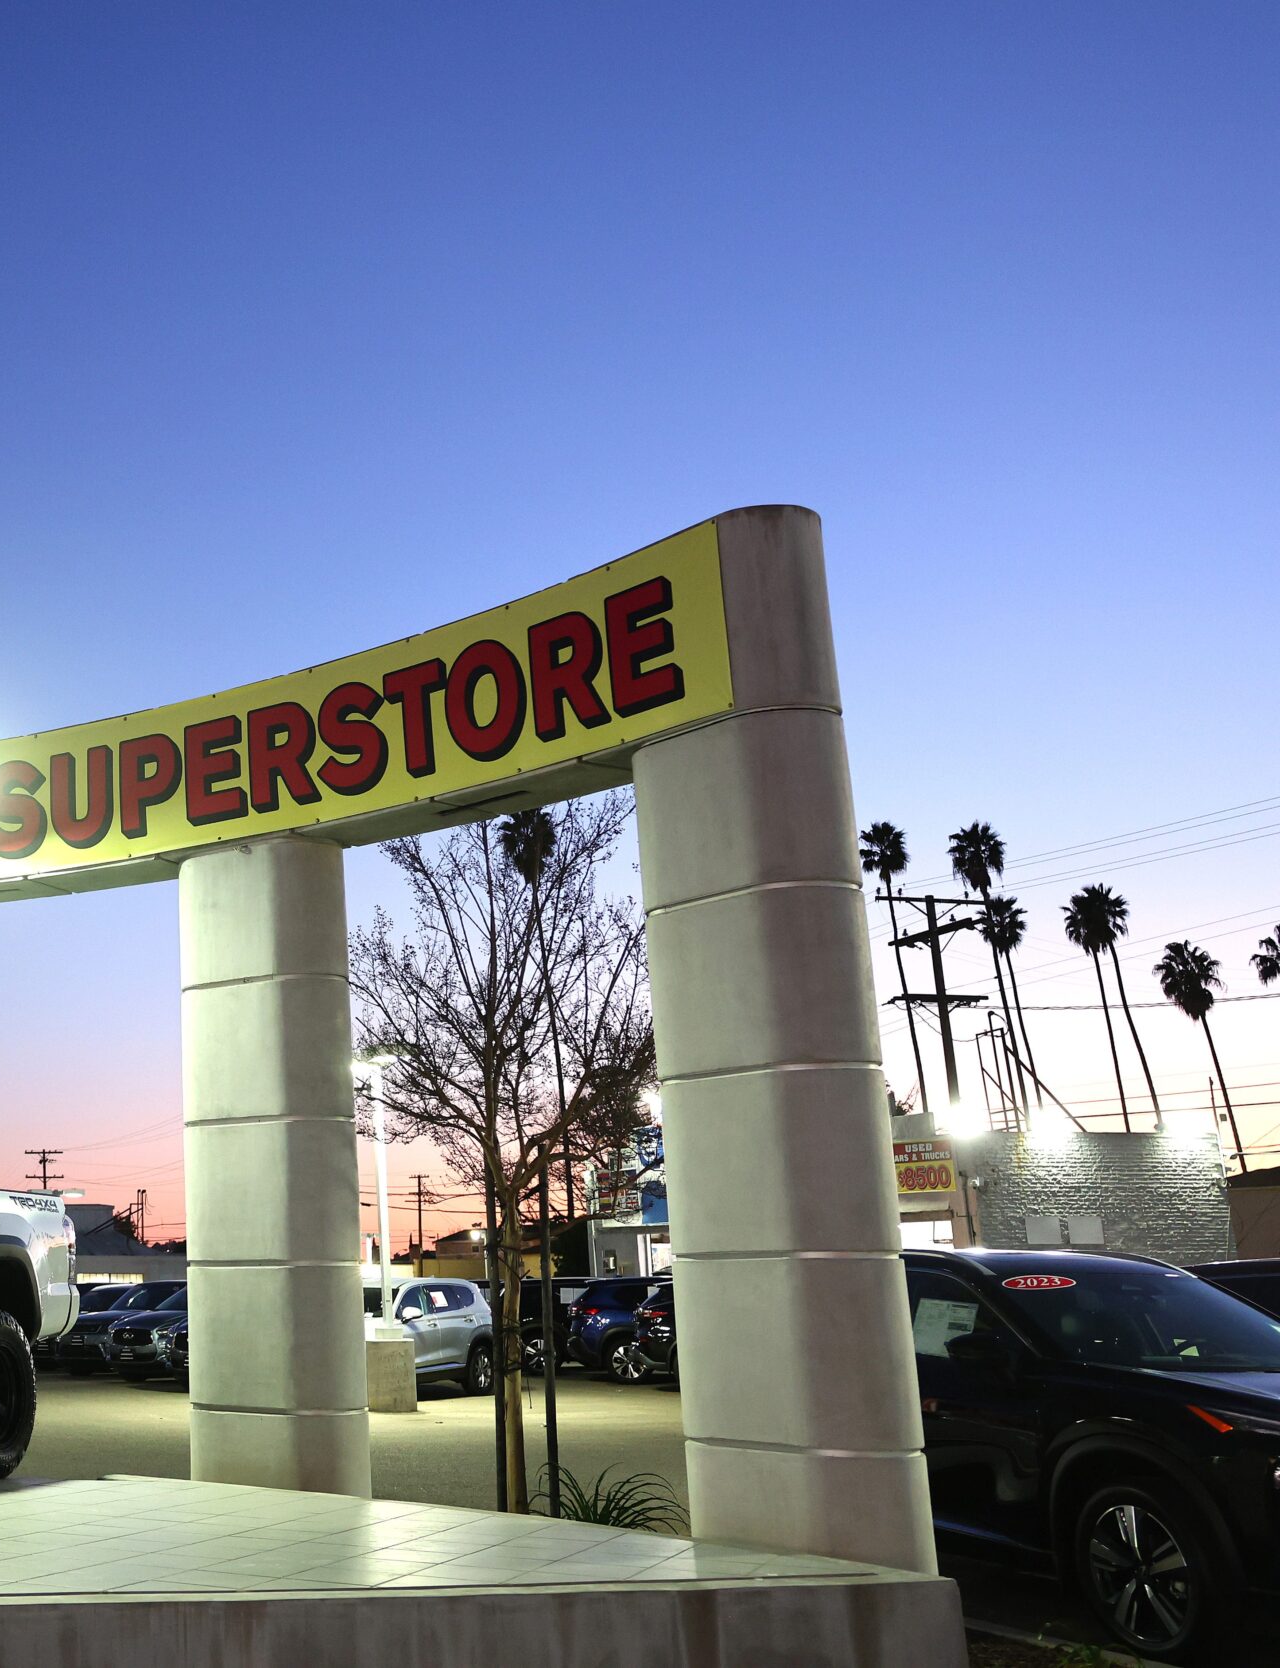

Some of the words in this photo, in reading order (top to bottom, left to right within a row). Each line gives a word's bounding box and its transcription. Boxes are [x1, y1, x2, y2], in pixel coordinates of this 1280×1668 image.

[904, 1143, 933, 1153] USED
[894, 1154, 909, 1163] ARS
[912, 1153, 918, 1161] &
[921, 1151, 951, 1160] TRUCKS
[897, 1164, 952, 1190] $8500
[9, 1195, 37, 1210] TRD
[1015, 1277, 1061, 1288] 2023
